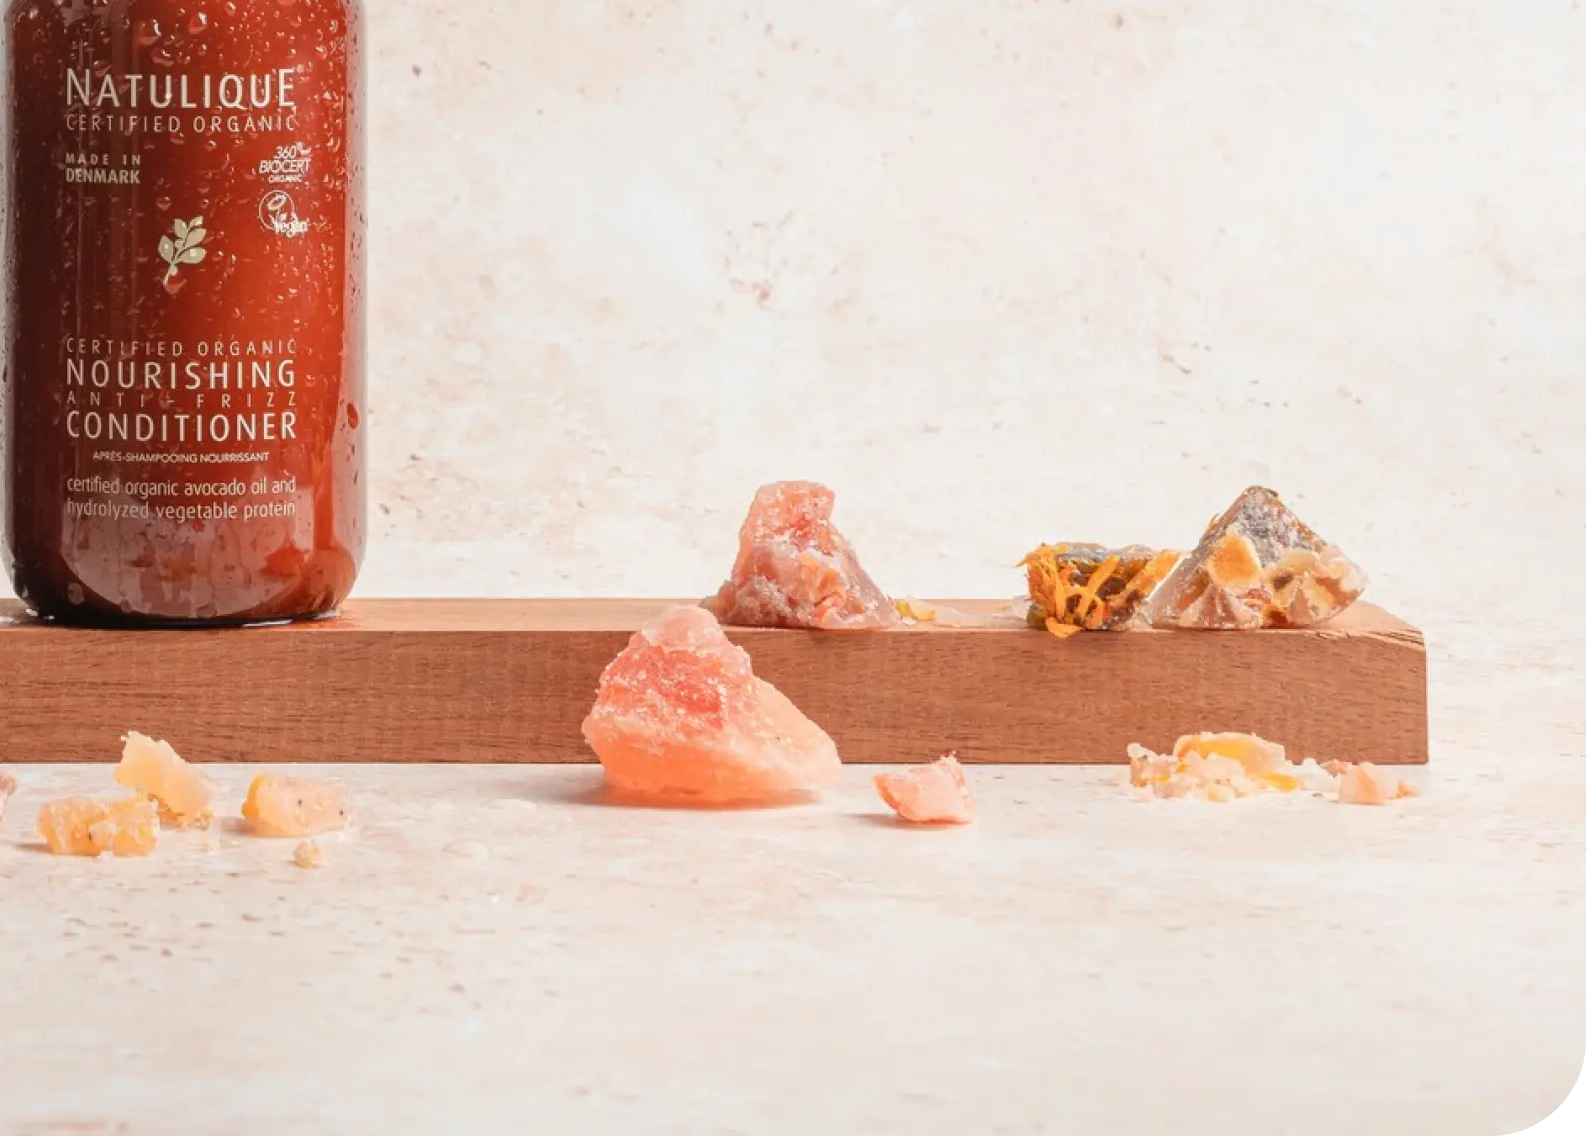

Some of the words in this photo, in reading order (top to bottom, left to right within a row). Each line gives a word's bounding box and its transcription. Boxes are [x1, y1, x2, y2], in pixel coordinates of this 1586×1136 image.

[66, 114, 181, 133] CERTIFIED
[193, 115, 297, 133] ORGANIC
[66, 152, 109, 165] MADE
[122, 154, 141, 166] IN
[259, 159, 311, 174] BIOCERT
[66, 167, 141, 184] DENMARK
[66, 338, 182, 356] CERTIFIED
[197, 339, 297, 356] ORGANIC
[66, 359, 296, 389] NOURISHING
[66, 410, 297, 442] CONDITIONER
[199, 451, 270, 463] NOURRISSANT
[67, 477, 120, 495] certified
[125, 479, 179, 501] organic
[184, 478, 246, 496] avocado
[251, 477, 267, 494] oil
[271, 476, 296, 494] and
[67, 499, 149, 522] hydrolyzed
[155, 502, 238, 523] vegetable
[243, 500, 296, 521] protein
